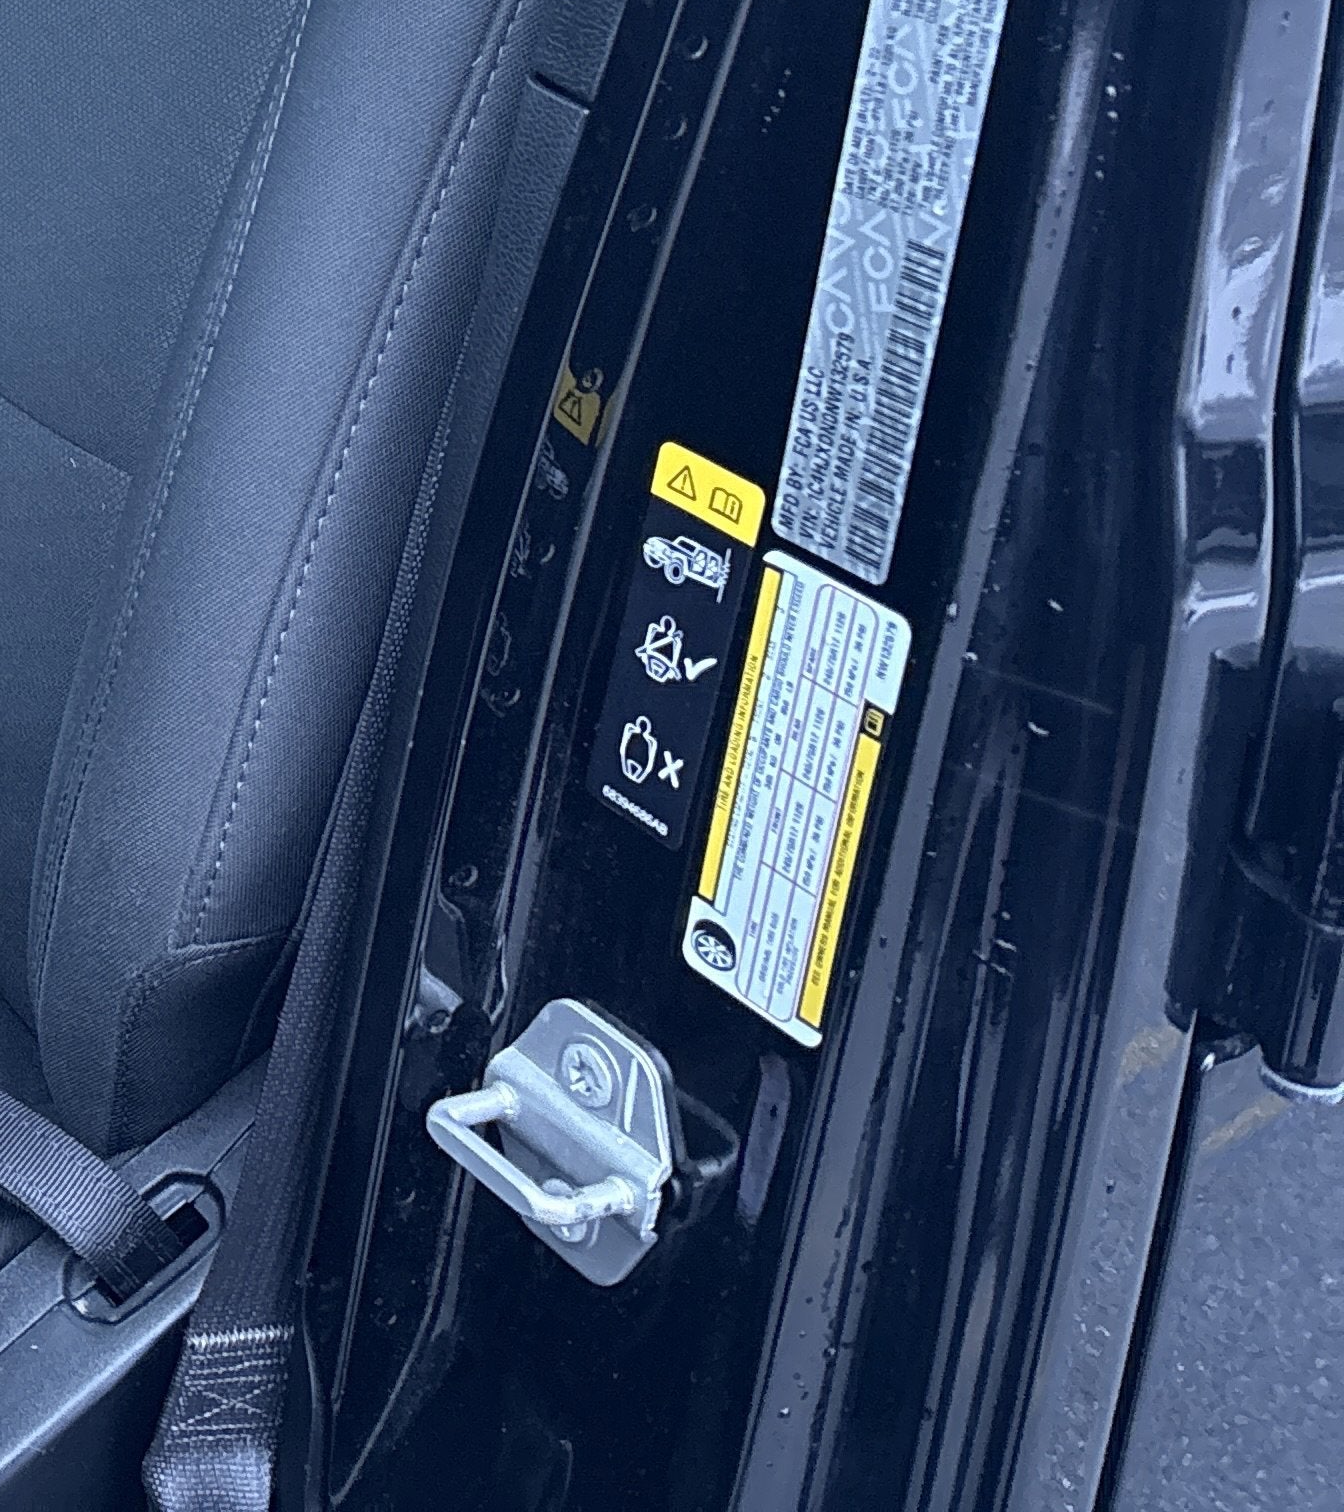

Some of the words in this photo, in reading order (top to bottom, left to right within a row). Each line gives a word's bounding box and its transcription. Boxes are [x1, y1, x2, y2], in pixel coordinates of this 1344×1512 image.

[803, 363, 826, 398] LLC
[797, 396, 819, 425] US
[791, 423, 813, 459] FCA
[832, 432, 857, 483] MADE
[784, 459, 806, 492] BY:
[777, 491, 800, 532] MFD
[798, 503, 819, 541] VIN:
[818, 482, 847, 552] VEHICLE
[736, 652, 759, 722] INFORMATION
[727, 720, 744, 767] LOADING
[722, 764, 735, 789] AND
[844, 767, 866, 829] INFORMATION
